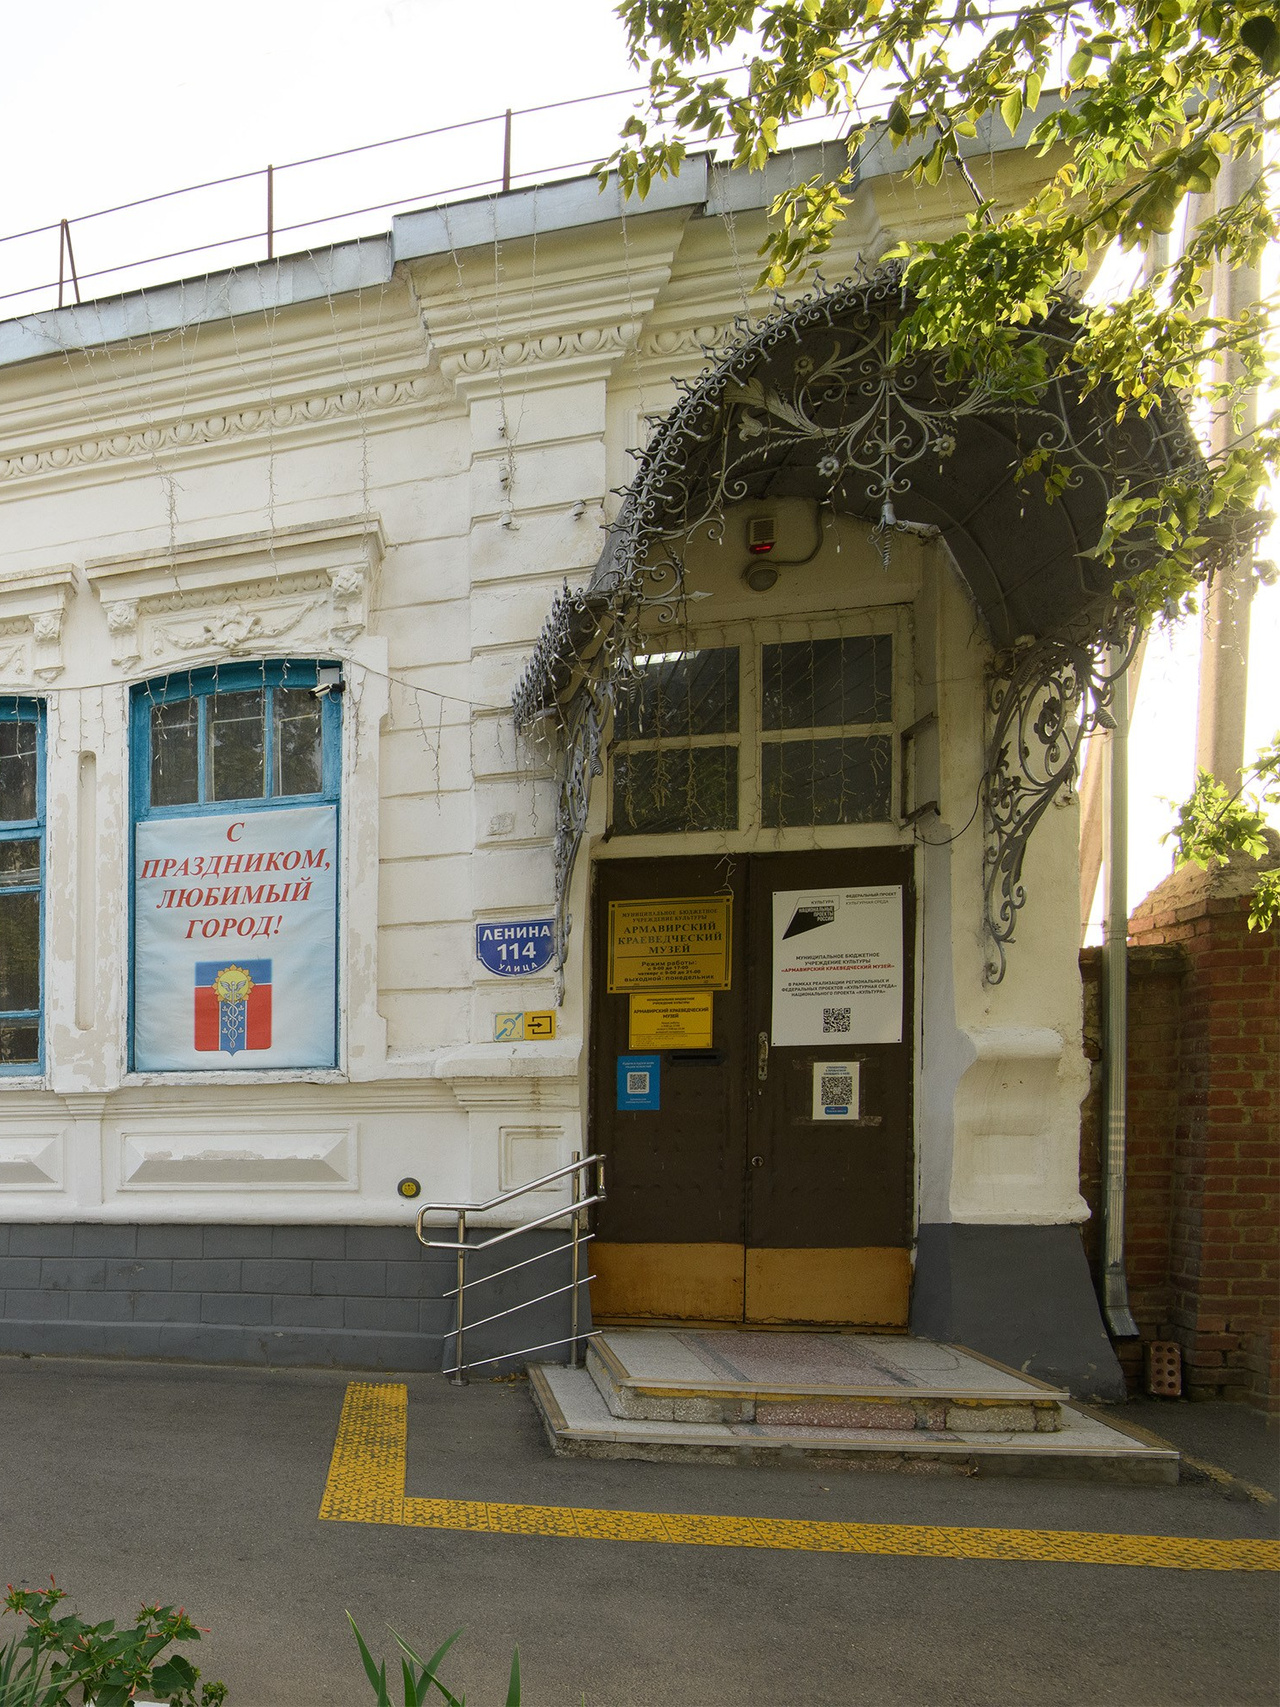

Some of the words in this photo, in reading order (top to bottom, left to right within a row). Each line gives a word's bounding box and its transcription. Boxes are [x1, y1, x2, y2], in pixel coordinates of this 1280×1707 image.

[226, 822, 246, 842] С
[140, 847, 331, 880] ПРАЗДНИКОМ,
[156, 877, 314, 909] ЛЮБИМЫЙ
[184, 915, 284, 940] ГОРОД!
[482, 925, 551, 941] ЛЕНИНА
[624, 921, 716, 934] АРМАВИРСКИЙ
[618, 932, 722, 944] КРАЕВЕДЧЕСКИЙ
[497, 942, 536, 960] 114
[649, 943, 690, 954] МУЗЕЙ
[498, 962, 538, 972] УЛИЦА
